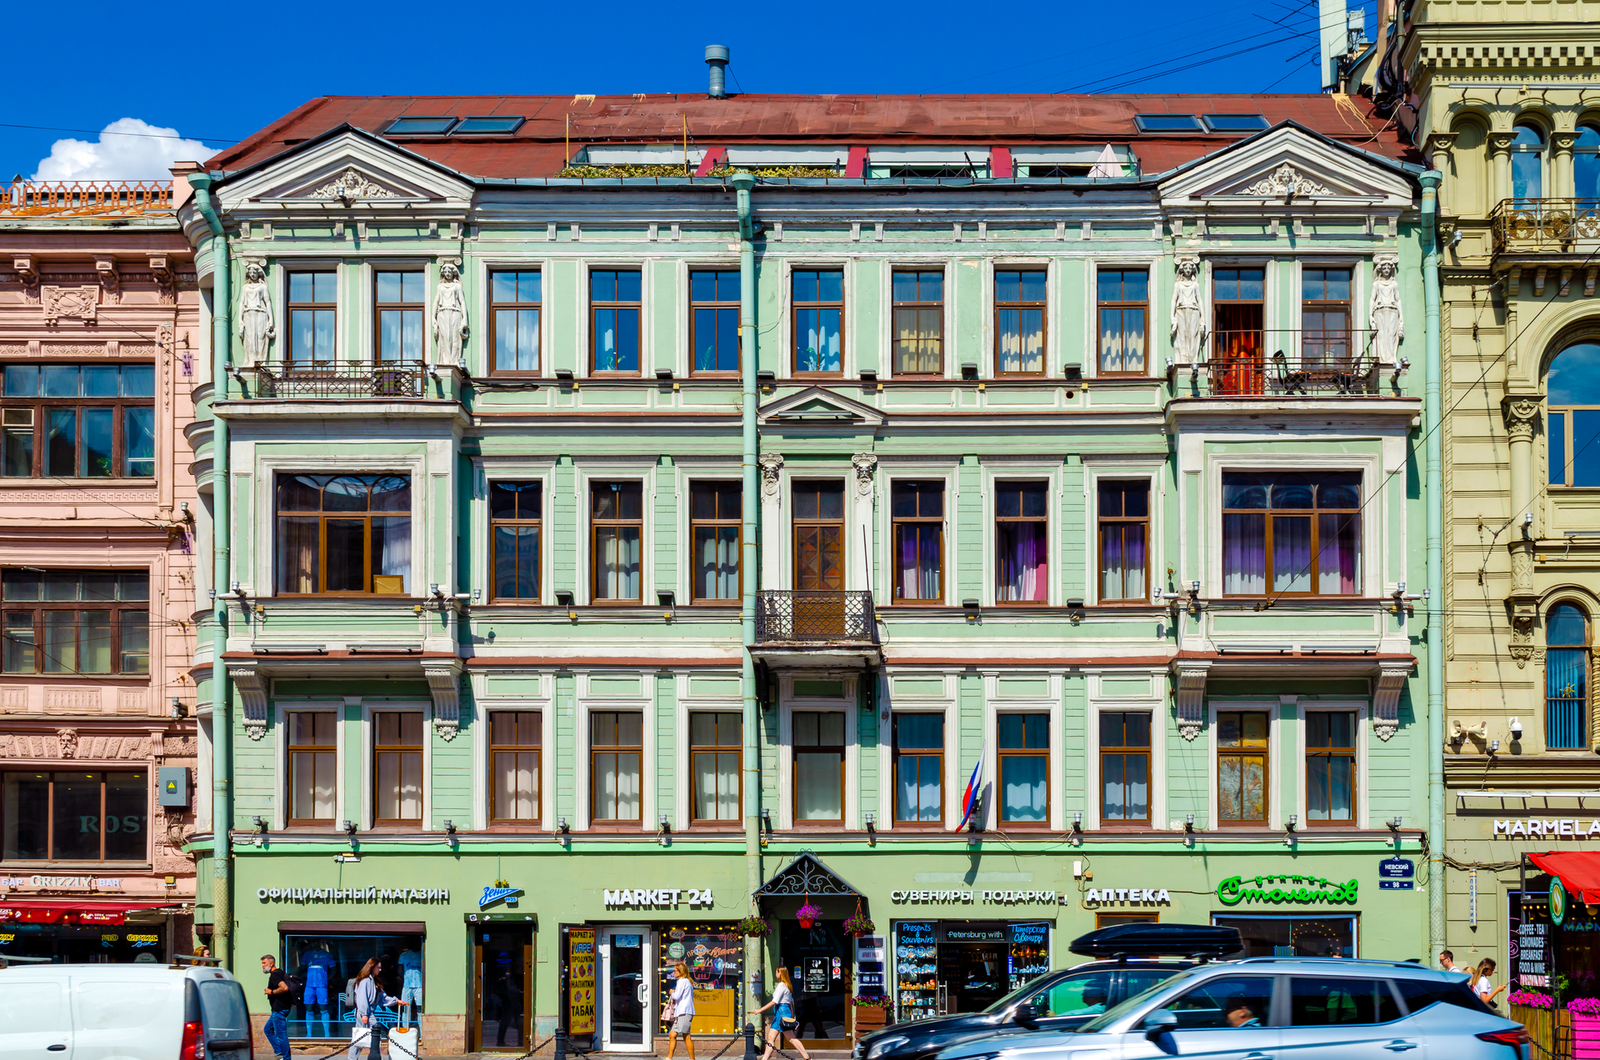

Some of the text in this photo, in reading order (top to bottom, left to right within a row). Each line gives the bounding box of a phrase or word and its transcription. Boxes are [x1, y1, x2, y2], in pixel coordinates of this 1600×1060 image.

[79, 815, 147, 833] ROS
[1, 878, 24, 886] БАР
[30, 875, 92, 887] GRIZZLY
[99, 878, 121, 887] BAR
[257, 885, 449, 901] ОФИЦИАЛЬНЫЙ МАГАЗИН
[1087, 888, 1171, 902] АПТЕКА
[1218, 876, 1359, 904] Столетов
[604, 888, 713, 905] MARKET 24
[891, 889, 1056, 903] СУВЕНИРЫ ПОДАРКИ
[903, 924, 932, 932] Presents
[901, 933, 934, 944] Souvenirs
[947, 930, 1004, 942] Petersburg with
[711, 946, 737, 957] Mars
[1519, 962, 1530, 973] FOOD
[571, 980, 594, 988] НАПИТКИ
[571, 1005, 594, 1016] ТАБАК
